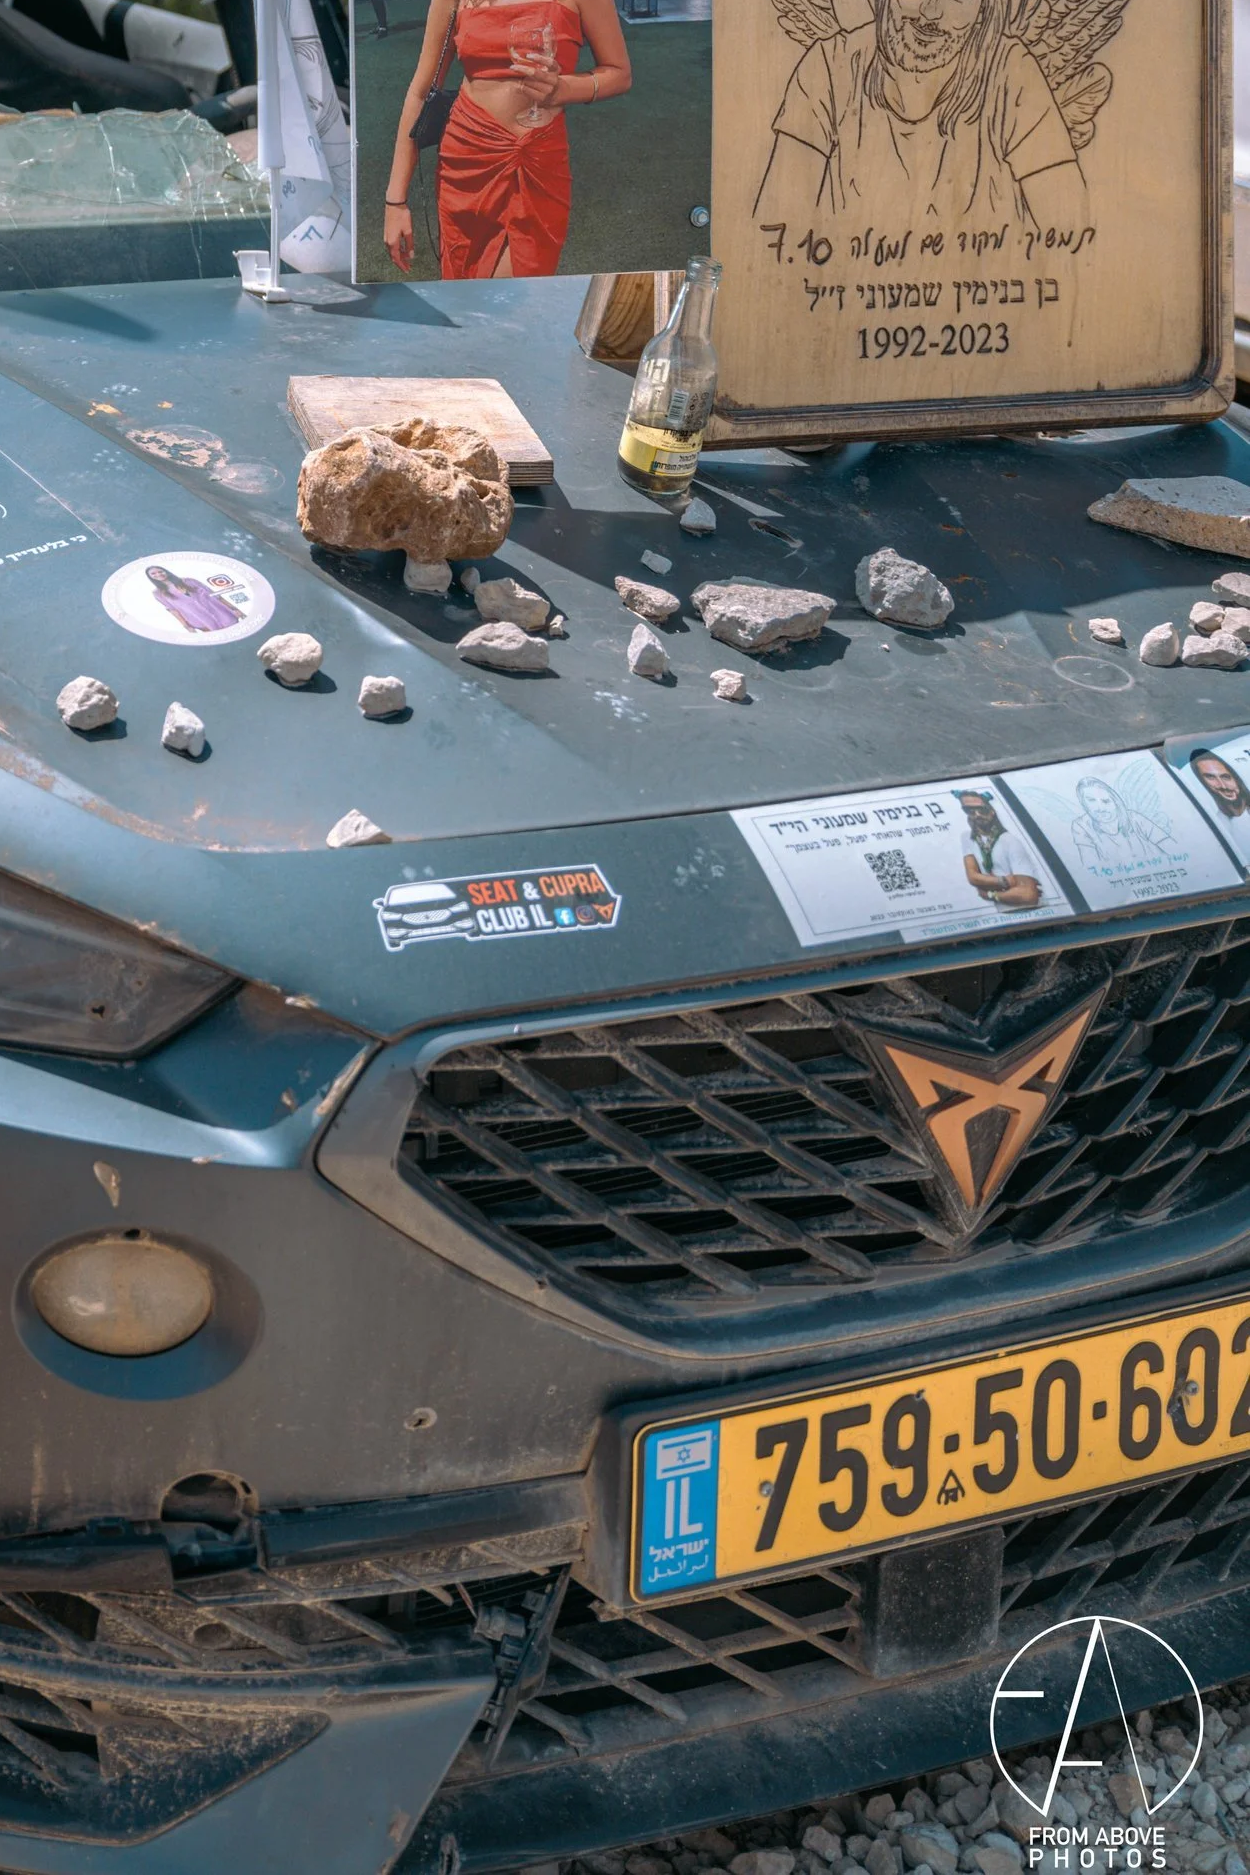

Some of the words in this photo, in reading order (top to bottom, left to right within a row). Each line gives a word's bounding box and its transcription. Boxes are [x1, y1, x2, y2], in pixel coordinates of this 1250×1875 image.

[760, 223, 833, 264] 7.10
[856, 281, 942, 310] שמעוני
[953, 278, 1024, 313] בנימין
[1034, 277, 1060, 309] בן
[858, 322, 1010, 359] 1992-2023
[69, 534, 88, 544] כי
[811, 812, 868, 830] שמעוני
[873, 804, 922, 826] בנימין
[924, 801, 945, 818] בן
[466, 879, 519, 906] SEAT
[522, 881, 541, 901] &
[539, 871, 606, 898] CUPRA
[475, 905, 529, 934] CLUB
[529, 903, 554, 929] IL
[664, 1476, 704, 1540] IL
[648, 1538, 710, 1563] ישראל
